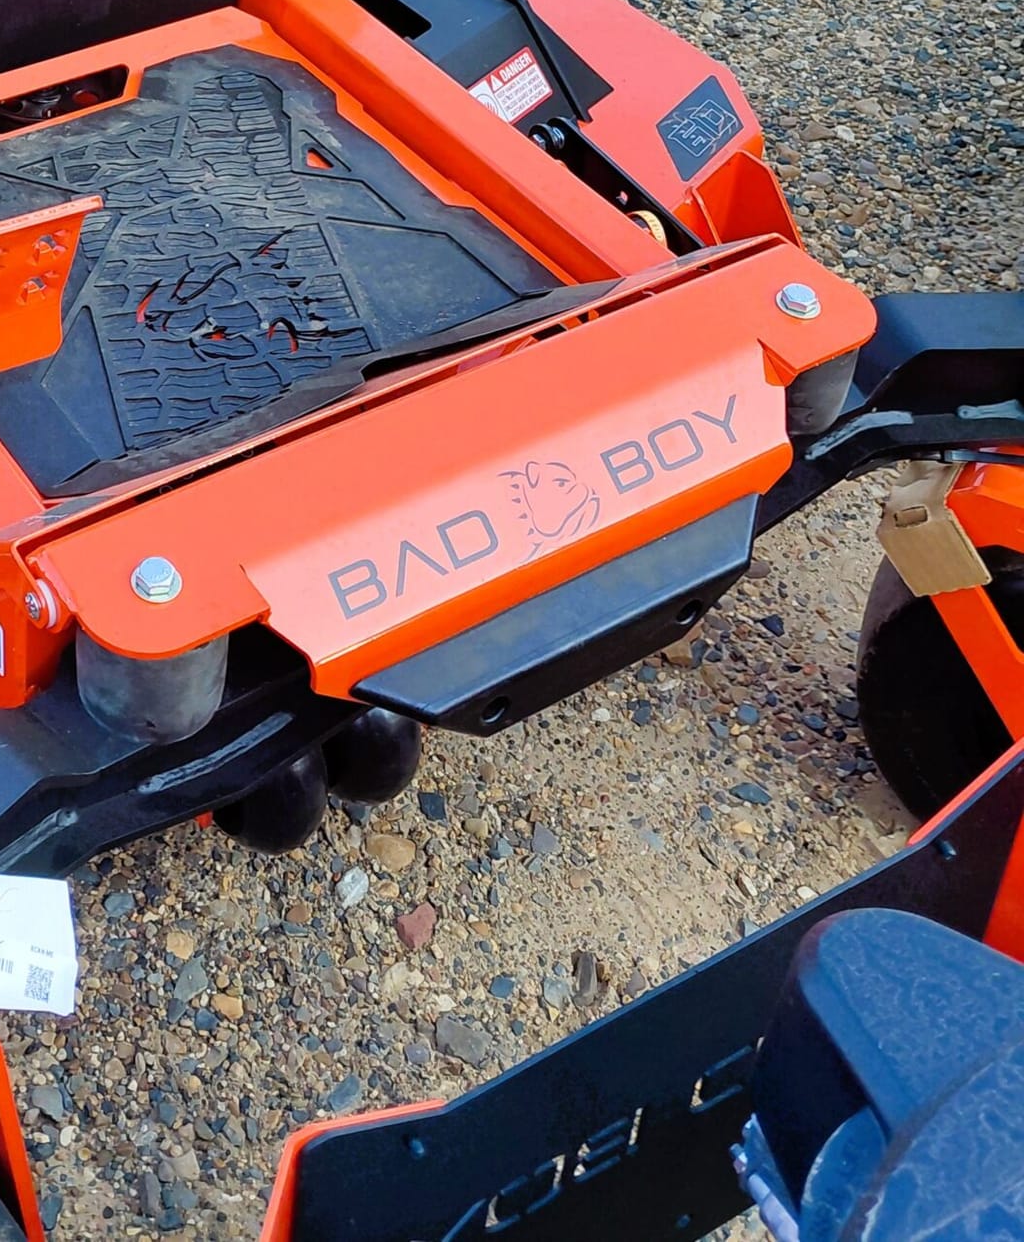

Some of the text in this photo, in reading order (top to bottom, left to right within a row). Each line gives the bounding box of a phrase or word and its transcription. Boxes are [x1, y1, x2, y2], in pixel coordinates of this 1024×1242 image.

[498, 52, 533, 83] DANGER
[327, 394, 738, 620] BAD BOY
